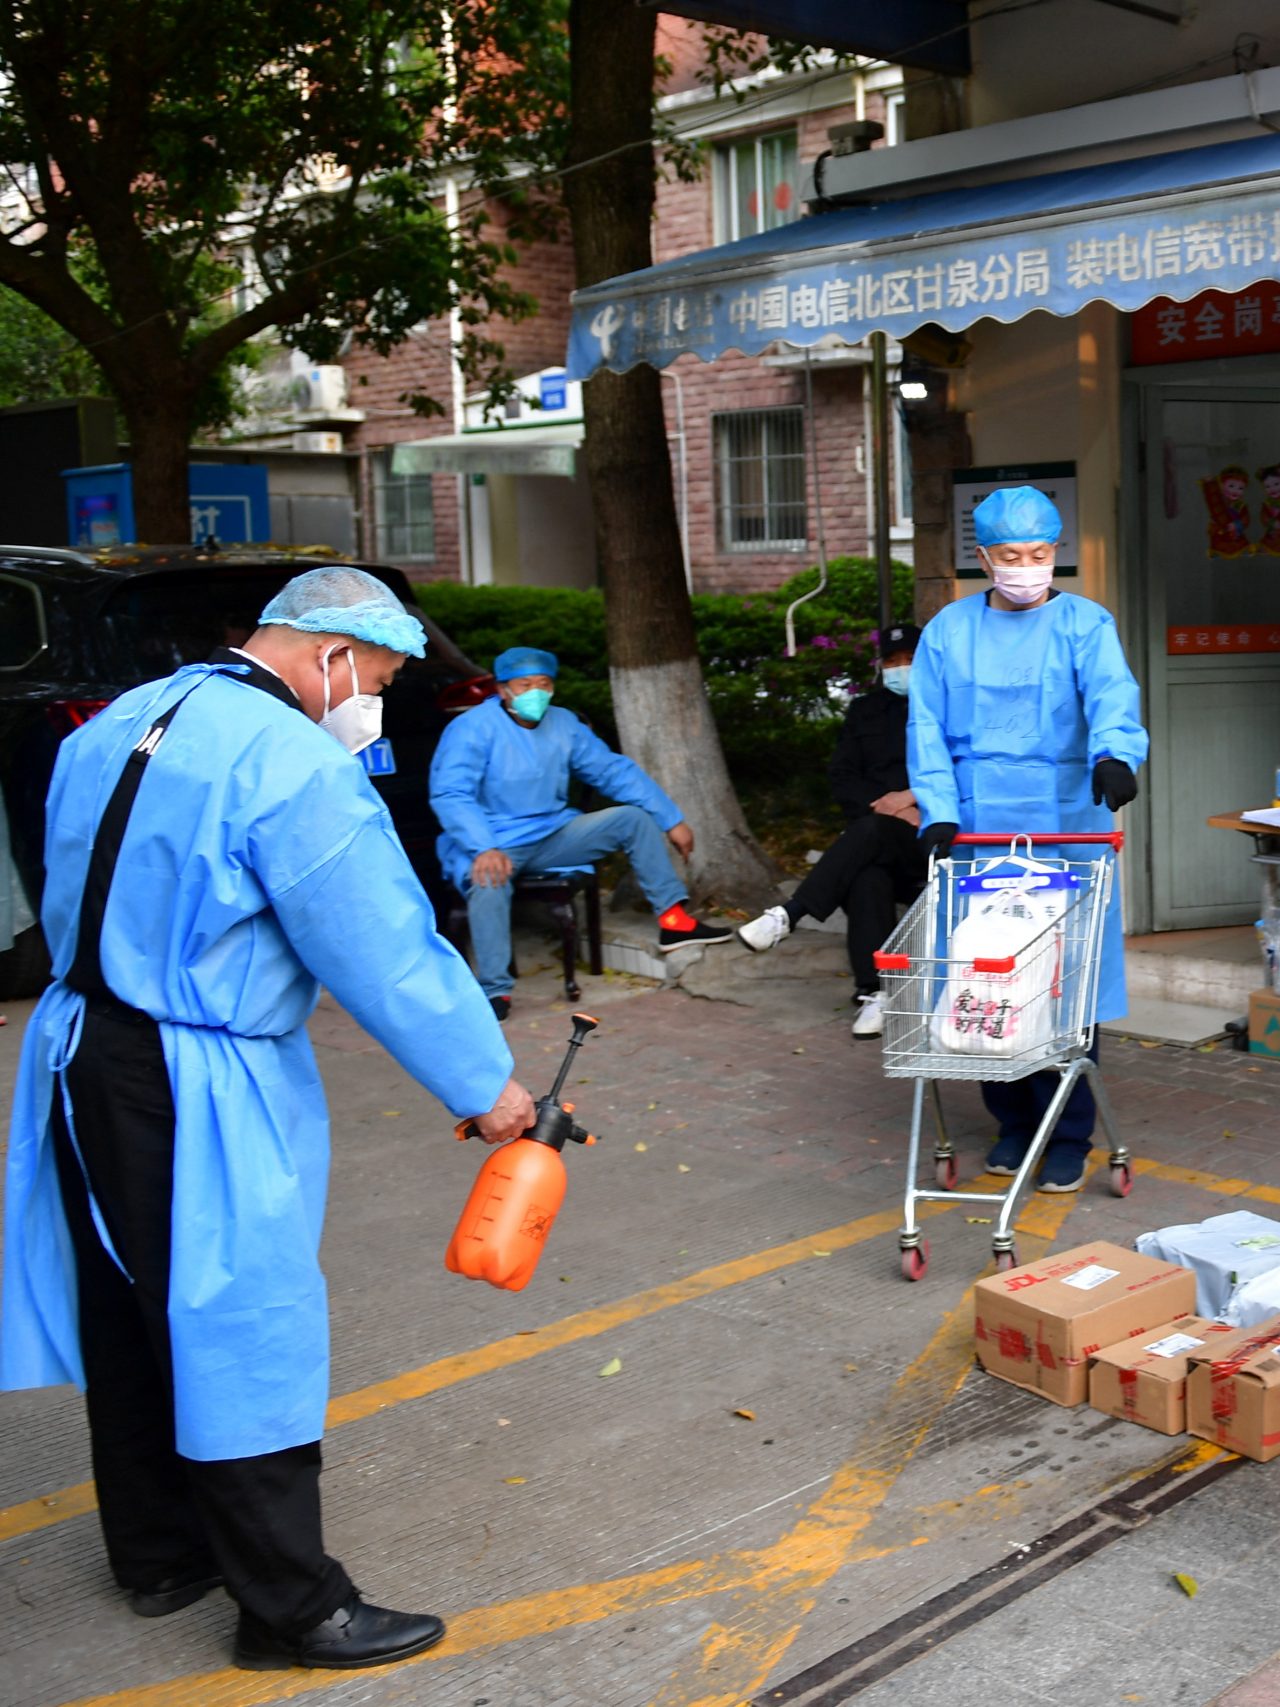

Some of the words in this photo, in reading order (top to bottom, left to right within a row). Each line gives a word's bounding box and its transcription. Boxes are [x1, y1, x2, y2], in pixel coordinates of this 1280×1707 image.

[729, 249, 1051, 332] 中国电信北区甘泉分局
[1003, 1273, 1049, 1292] JDL
